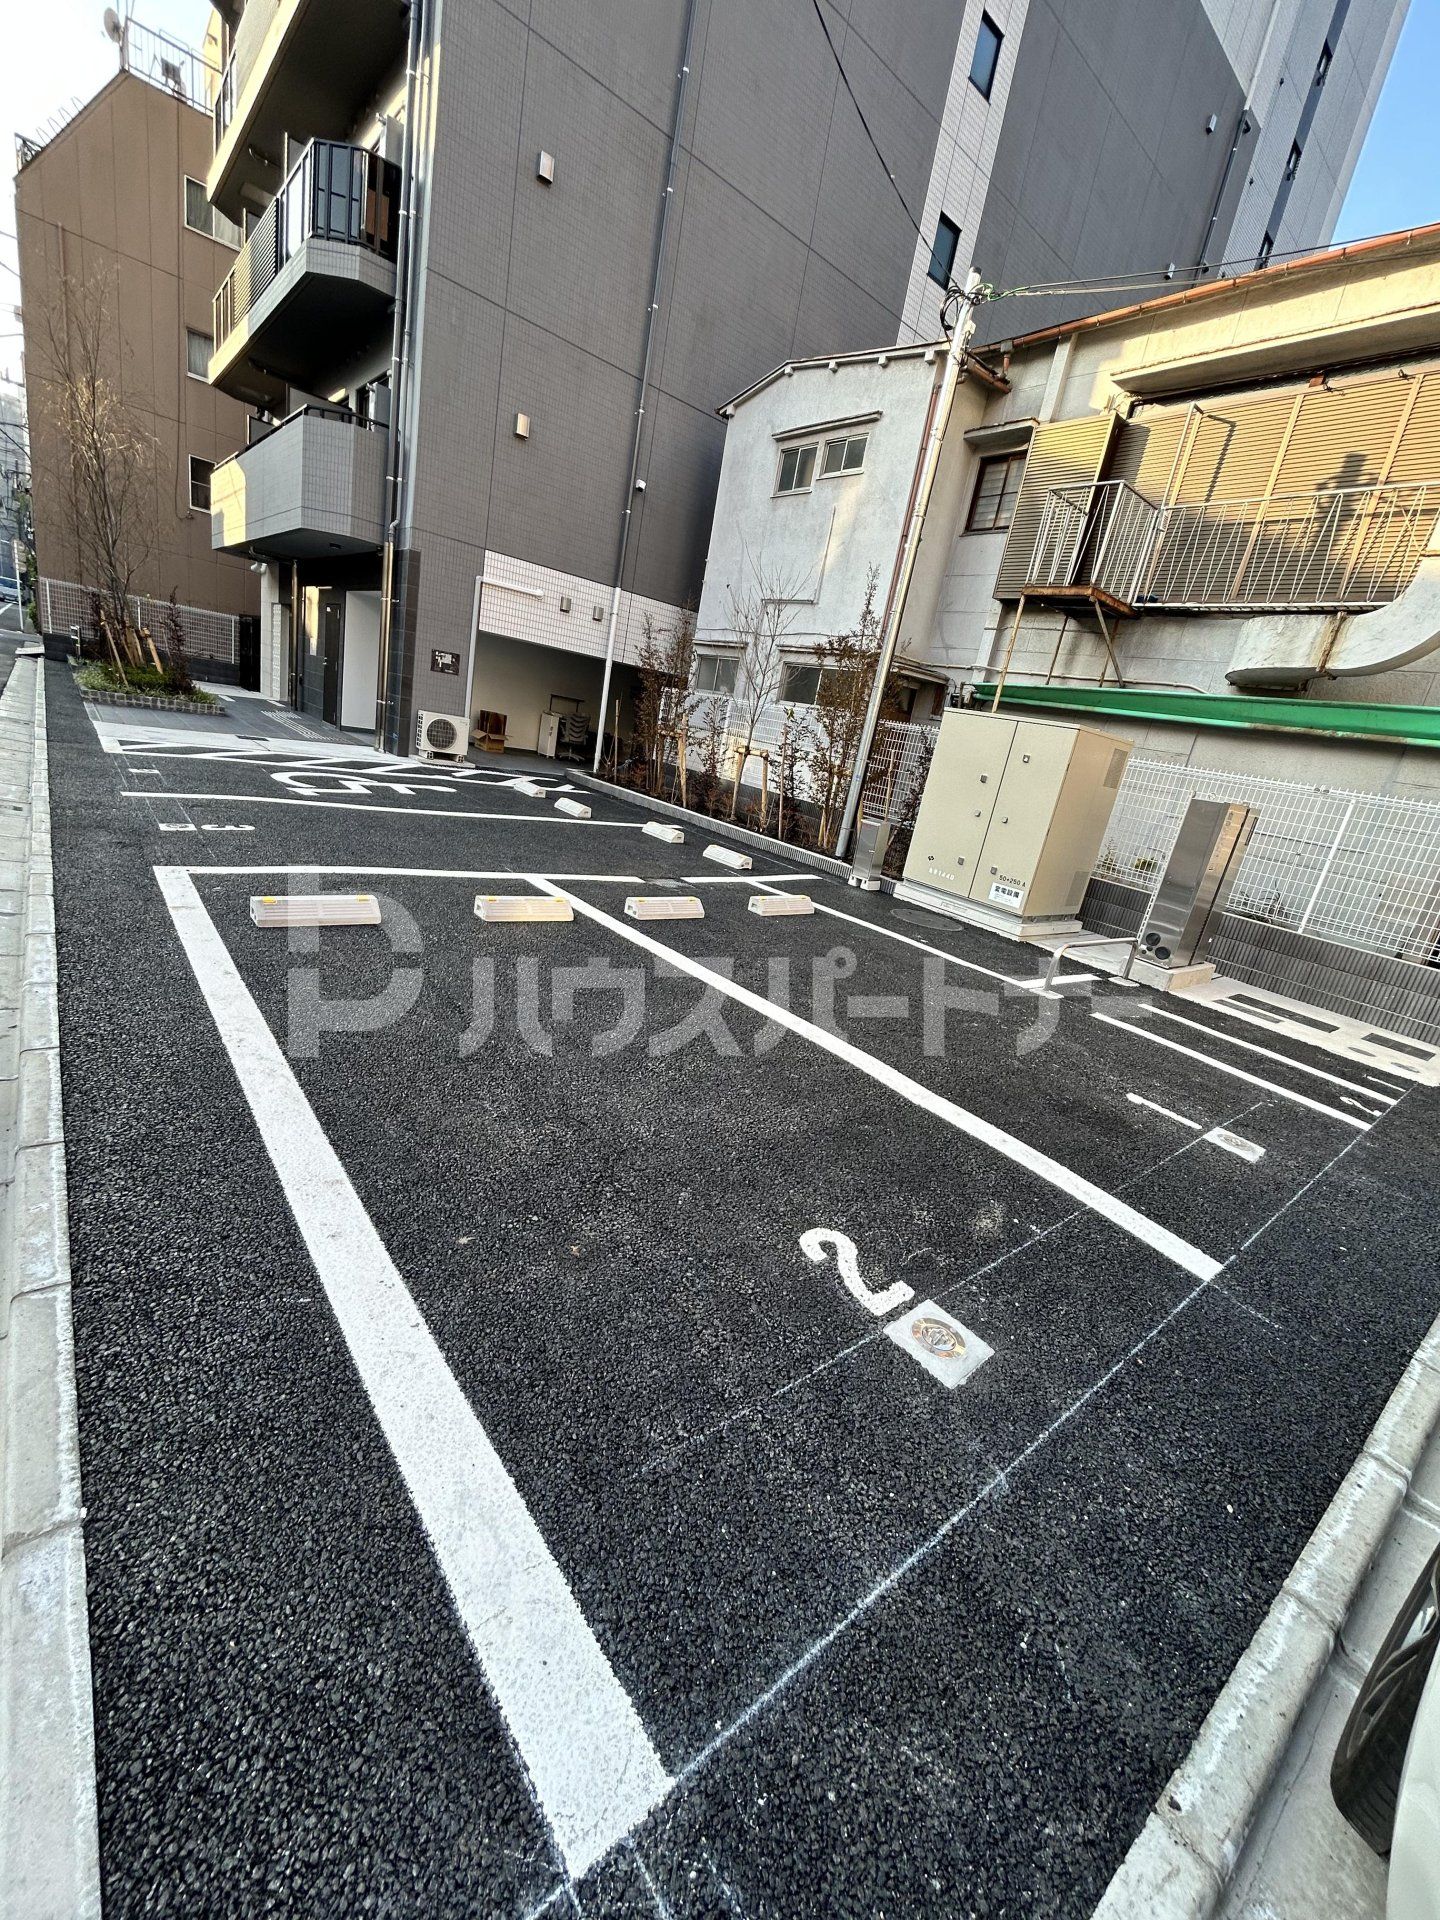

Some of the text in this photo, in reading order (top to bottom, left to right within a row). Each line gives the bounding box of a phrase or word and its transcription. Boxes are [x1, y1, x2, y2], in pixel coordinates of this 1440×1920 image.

[1125, 1092, 1203, 1130] 1
[1339, 1096, 1383, 1117] 2
[799, 1227, 915, 1316] 2
